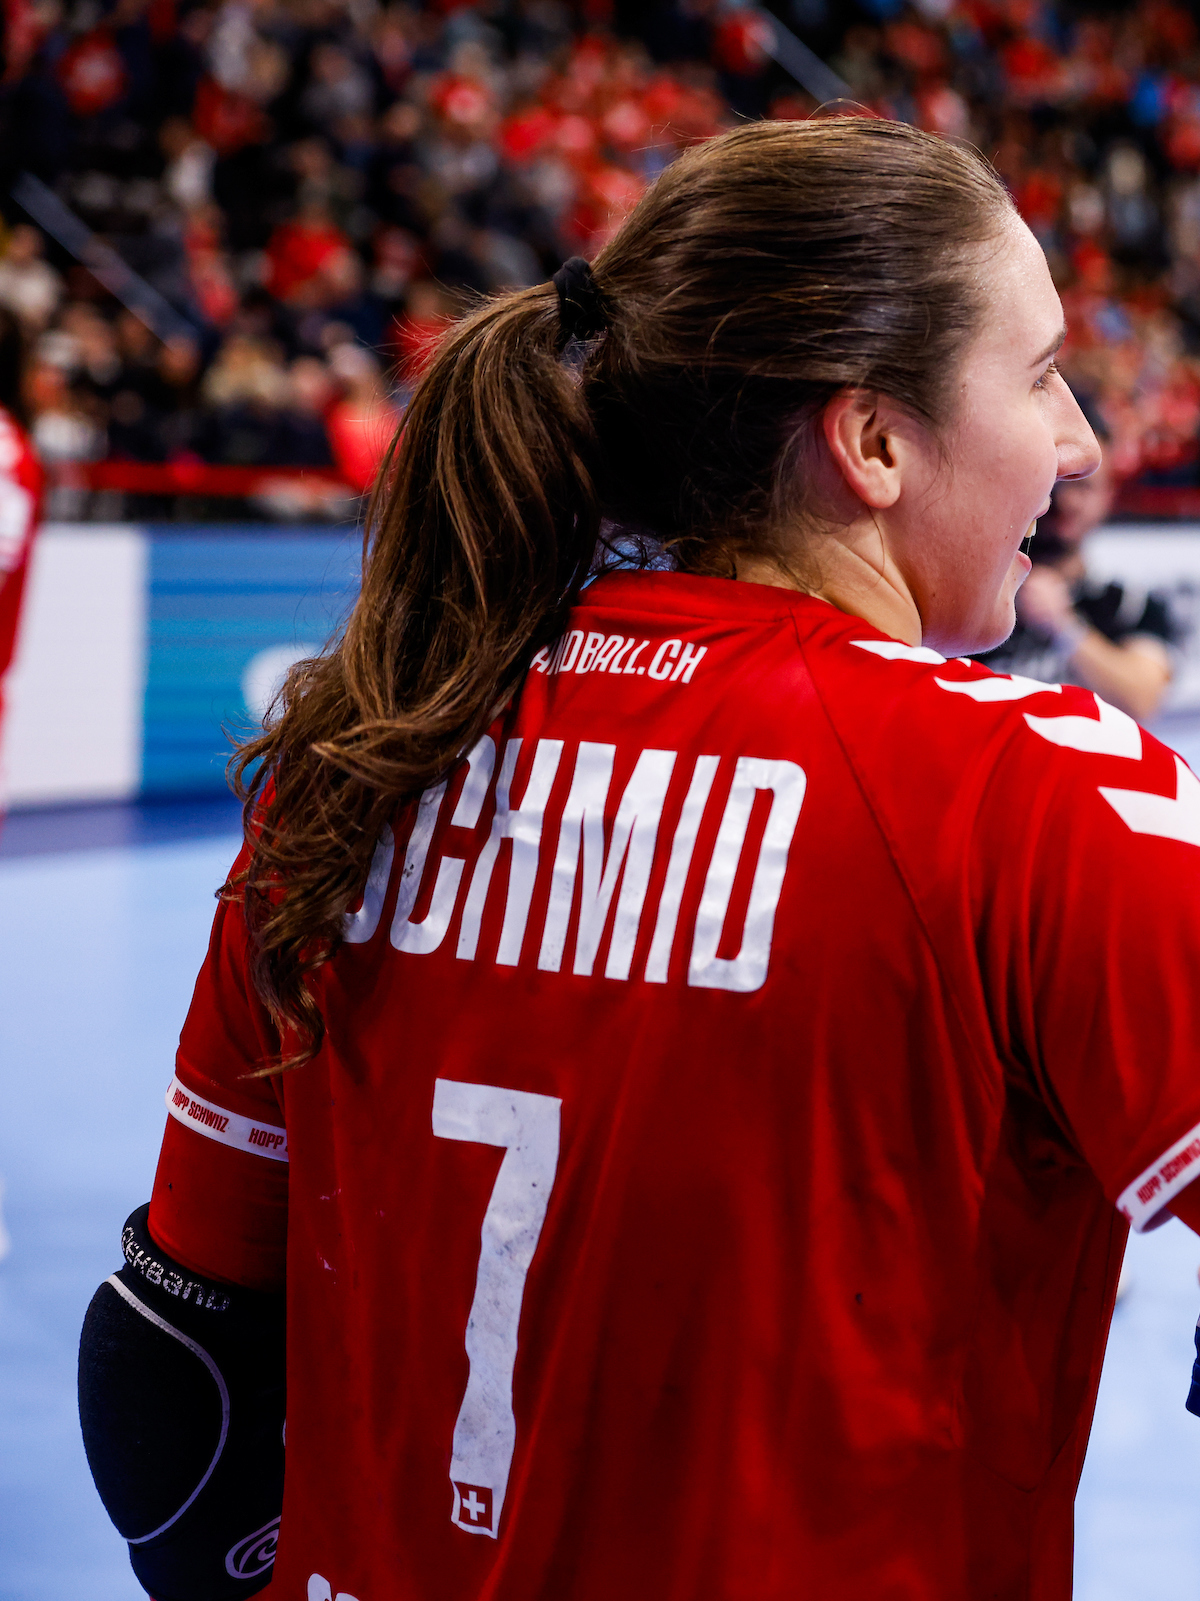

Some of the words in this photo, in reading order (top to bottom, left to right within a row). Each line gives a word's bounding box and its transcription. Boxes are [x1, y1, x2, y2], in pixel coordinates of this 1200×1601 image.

[171, 1087, 190, 1111] HOPP
[248, 1127, 285, 1150] HOPP
[431, 1077, 563, 1540] 7
